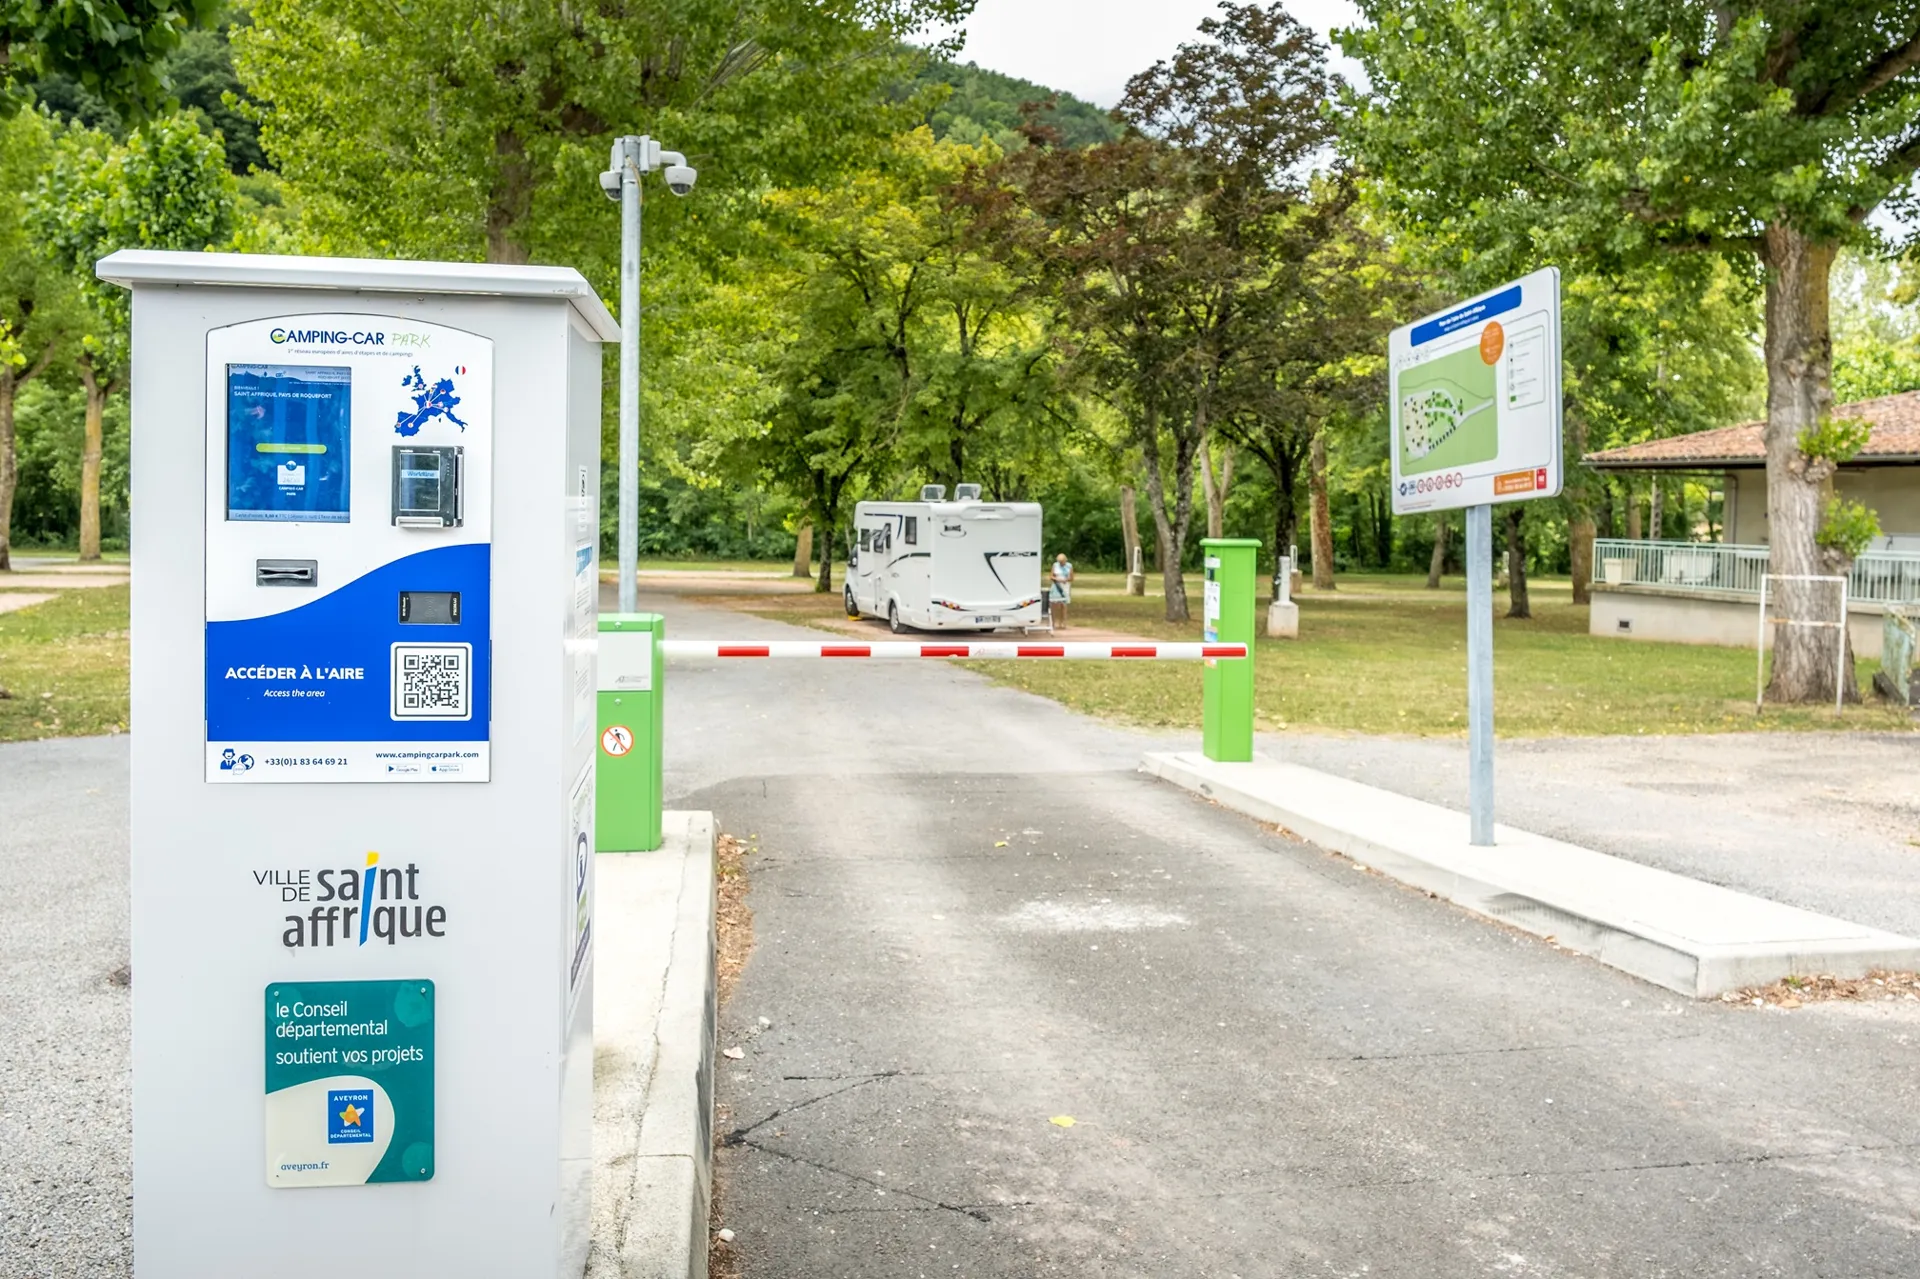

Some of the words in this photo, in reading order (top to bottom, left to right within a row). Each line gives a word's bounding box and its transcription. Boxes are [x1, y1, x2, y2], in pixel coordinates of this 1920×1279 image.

[270, 328, 385, 346] CAMPING-CAR
[391, 332, 432, 349] PARK
[354, 349, 376, 357] d'étapes
[225, 664, 297, 680] ACCÉDER
[300, 664, 313, 680] À
[316, 667, 365, 680] L'AIRE
[264, 689, 290, 698] Access
[291, 689, 305, 698] the
[306, 690, 326, 698] area
[264, 758, 298, 767] +33(0)1
[299, 758, 310, 766] 83
[312, 758, 323, 766] 64
[325, 758, 336, 766] 69
[337, 758, 348, 766] 21
[375, 751, 479, 760] www.campingcarpark.com
[253, 869, 311, 886] VILLE
[316, 851, 420, 902] saint
[282, 886, 311, 902] DE
[282, 904, 447, 948] affrique
[276, 1002, 290, 1018] le
[293, 1000, 348, 1018] Conseil
[275, 1019, 388, 1041] départemental
[275, 1048, 338, 1065] soutient
[342, 1050, 368, 1063] vos
[371, 1045, 424, 1065] projets
[280, 1161, 330, 1172] aveyron.fr
